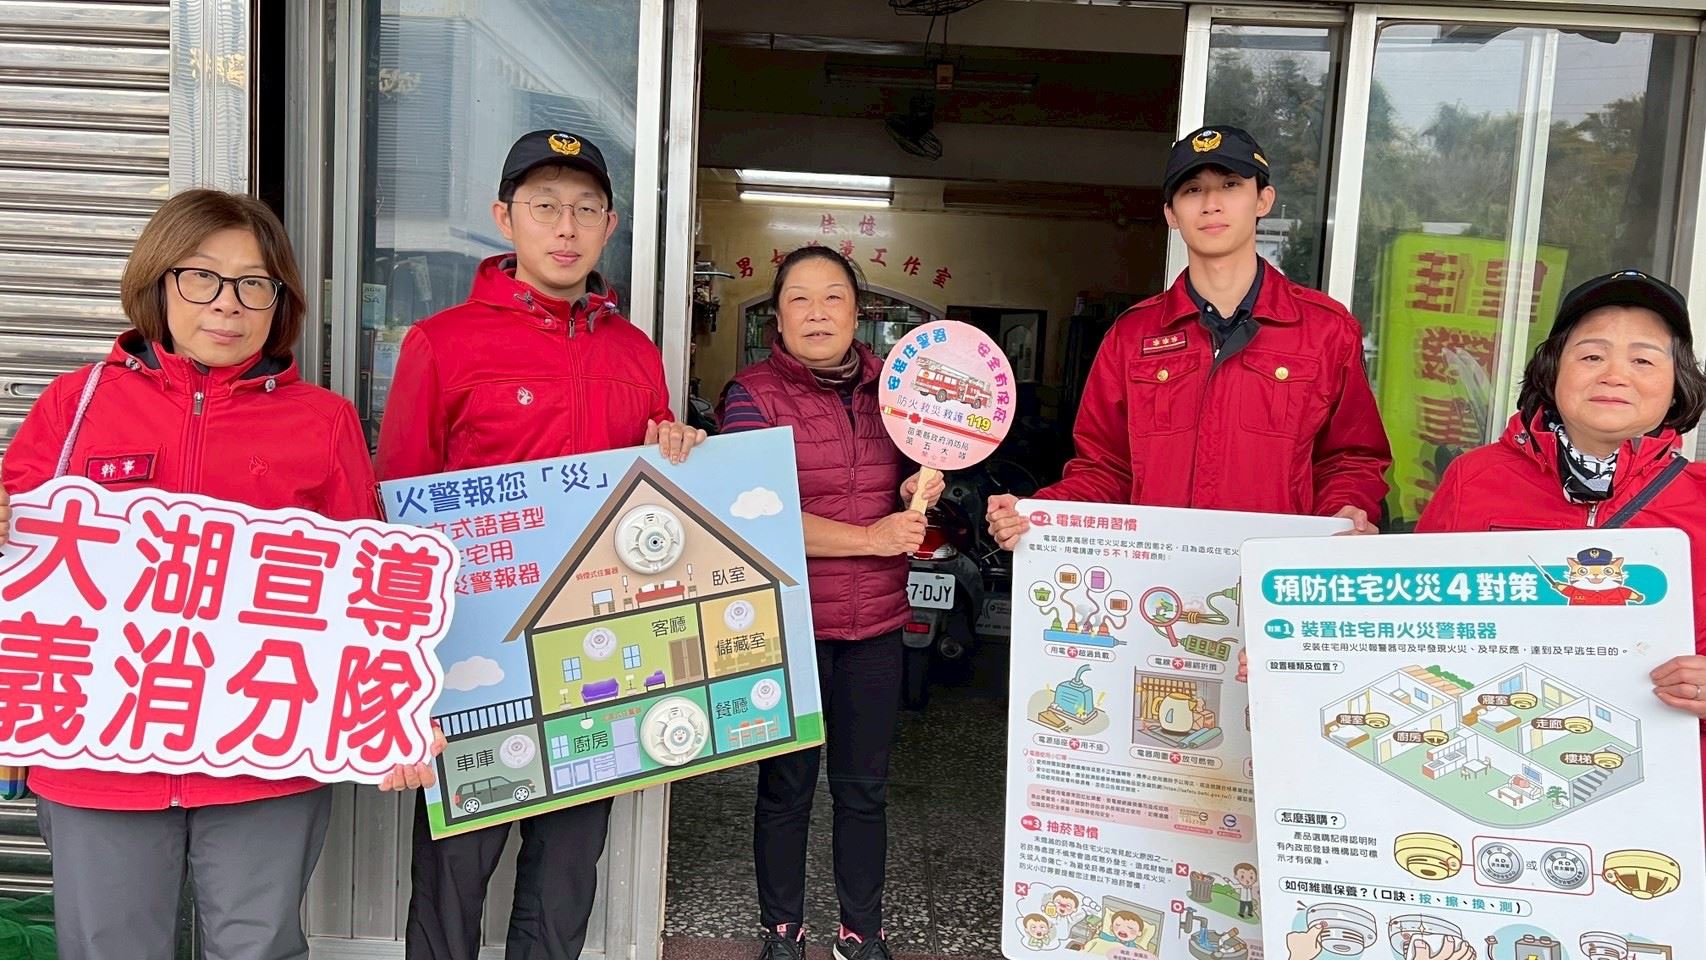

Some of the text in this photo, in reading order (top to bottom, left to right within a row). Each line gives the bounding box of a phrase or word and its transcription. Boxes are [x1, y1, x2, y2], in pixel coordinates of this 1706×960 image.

[966, 413, 992, 432] 119
[907, 426, 969, 451] 苗栗縣政府消防局
[101, 459, 136, 478] 幹事
[396, 460, 609, 518] 火警報您「災」
[416, 505, 546, 541] 立式語音型
[1056, 513, 1138, 532] 電氣使用習慣
[2, 499, 440, 641] 大湖宣導
[712, 566, 746, 587] 臥室
[1273, 572, 1539, 603] 預防住宅火災4對策
[651, 615, 687, 638] 客廳
[1301, 620, 1497, 640] 裝置住宅用火災警報器
[716, 632, 766, 657] 儲藏室
[0, 611, 422, 763] 義消分隊
[715, 697, 749, 720] 餐廳
[1482, 695, 1508, 706] 寢室
[1339, 714, 1365, 725] 寢室
[1535, 718, 1563, 730] 走廊
[573, 730, 610, 755] 廚房
[1396, 731, 1422, 743] 廚房
[455, 748, 496, 773] 車庫
[1563, 752, 1592, 765] 樓梯
[1280, 811, 1338, 826] 怎麼選購？
[1046, 819, 1100, 841] 抽菸習慣
